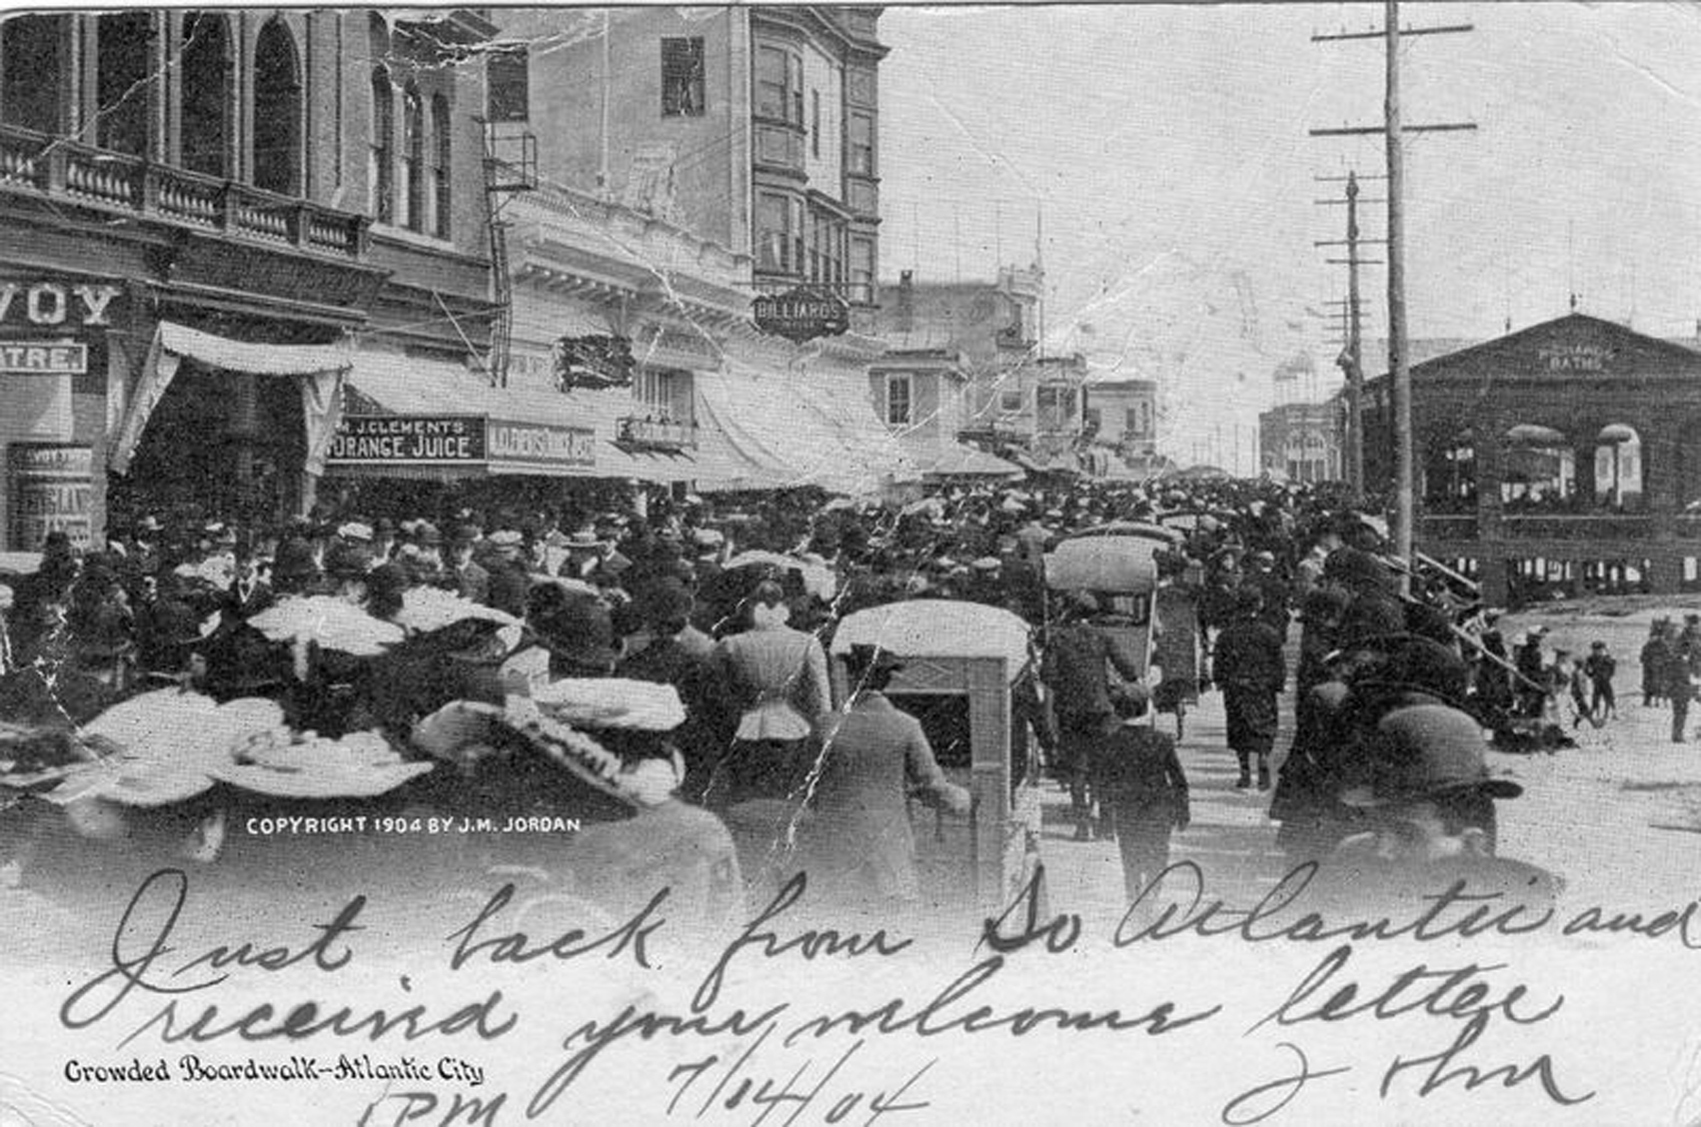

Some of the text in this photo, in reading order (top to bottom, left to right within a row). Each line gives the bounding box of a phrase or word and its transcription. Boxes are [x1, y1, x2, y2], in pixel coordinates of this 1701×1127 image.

[333, 434, 405, 458] ORANGE
[412, 434, 472, 459] JUICE
[59, 868, 367, 1030] Just
[446, 882, 671, 970] back
[691, 870, 914, 1014] from
[1112, 859, 1556, 949] Atlantic
[784, 954, 1222, 1049] welcome
[1243, 945, 1566, 1040] letter
